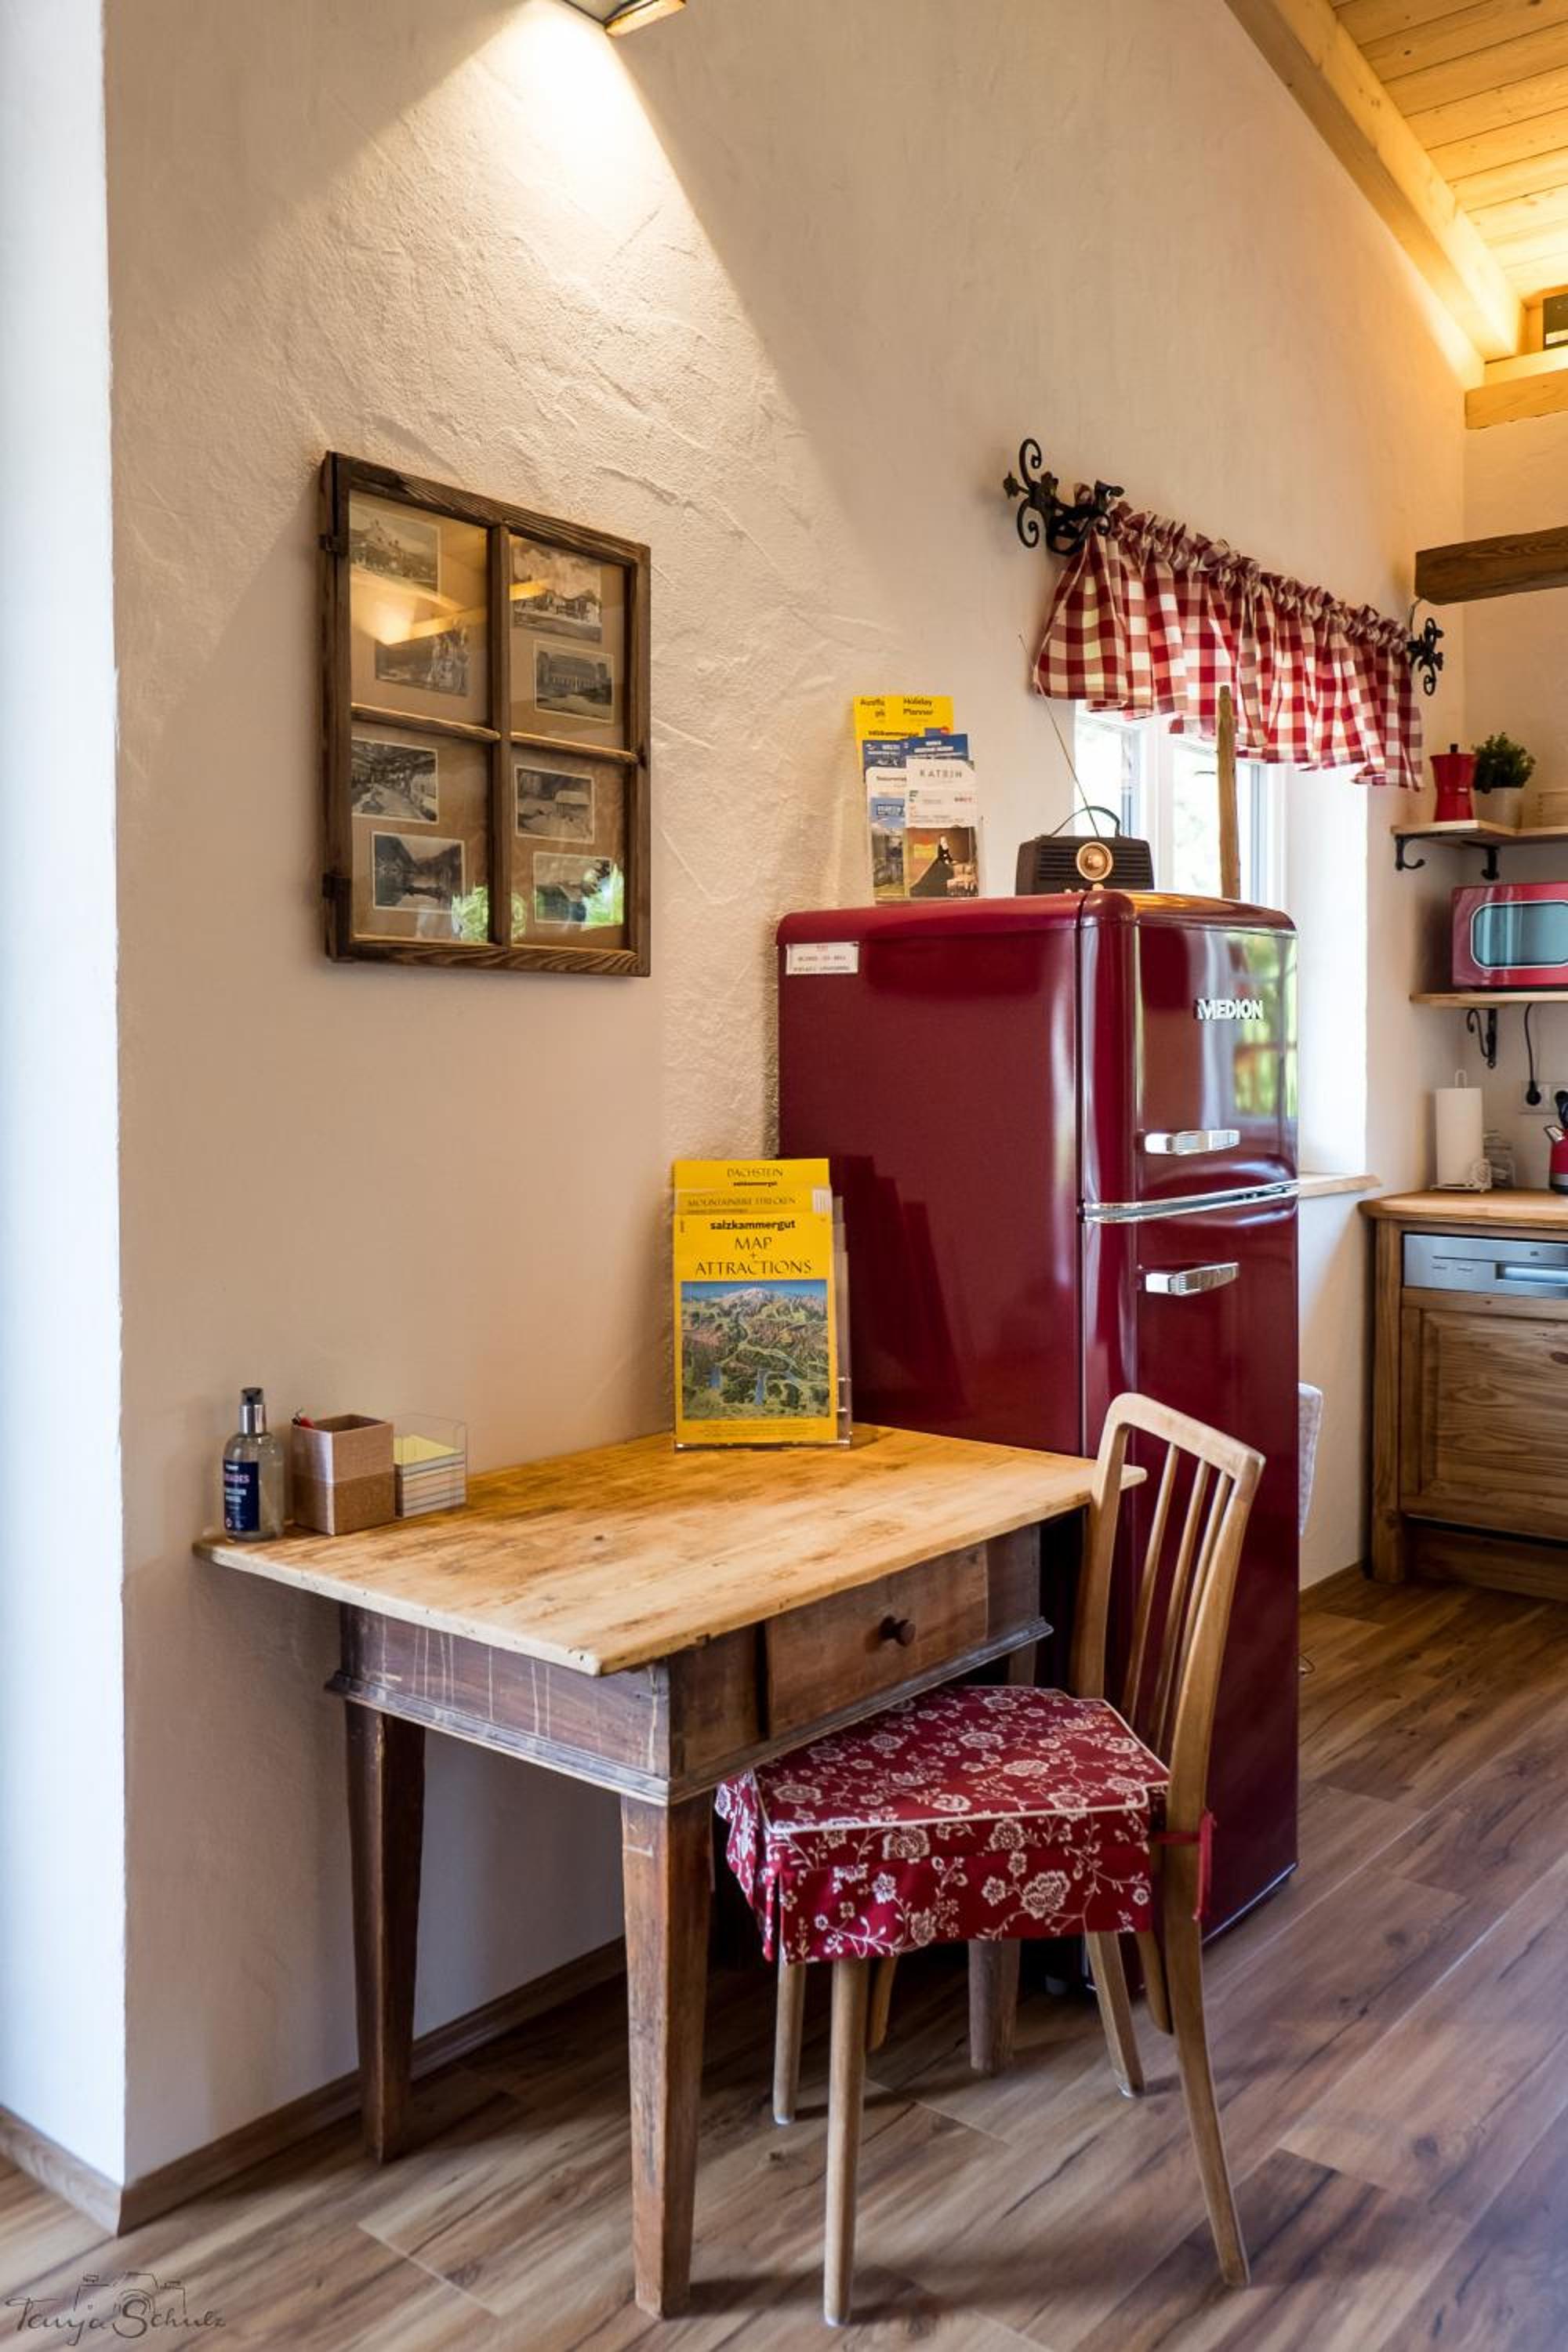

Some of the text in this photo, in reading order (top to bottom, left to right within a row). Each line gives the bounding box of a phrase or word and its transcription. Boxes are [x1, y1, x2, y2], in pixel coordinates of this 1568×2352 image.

[1196, 998, 1264, 1020] MEDION
[727, 1167, 783, 1178] DACHSTEIN
[710, 1219, 796, 1232] salzkammergut
[733, 1236, 772, 1250] MAP
[695, 1259, 813, 1276] ATTRACTIONS
